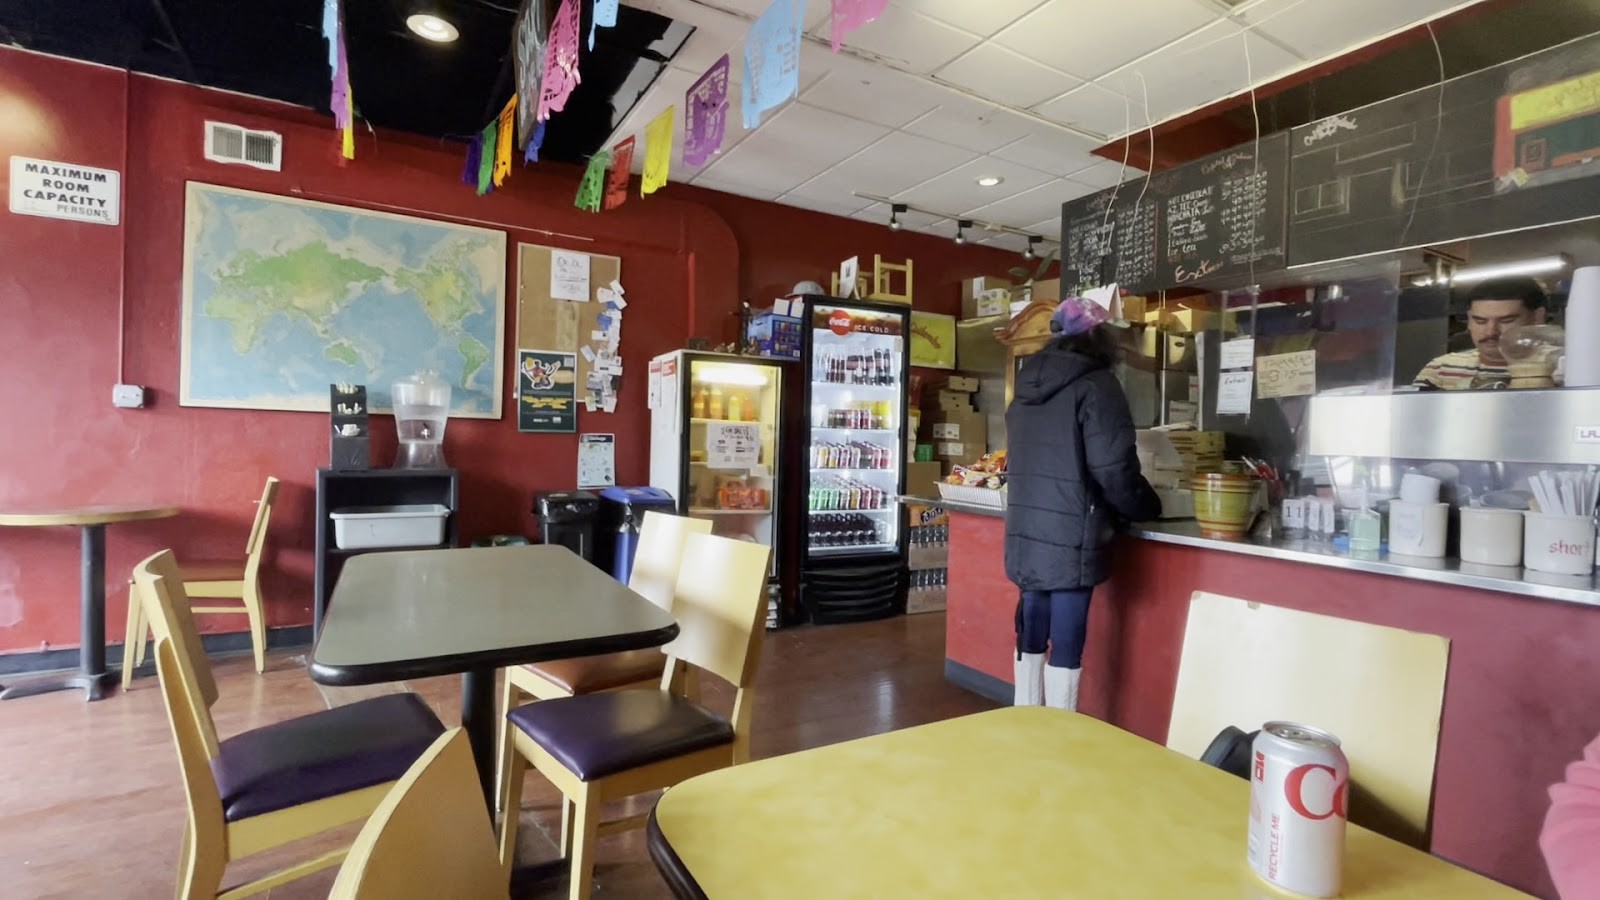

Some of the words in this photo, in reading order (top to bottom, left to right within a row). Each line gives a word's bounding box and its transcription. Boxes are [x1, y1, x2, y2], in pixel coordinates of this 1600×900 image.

[25, 163, 107, 183] MAXIMUM
[42, 178, 89, 193] ROOM
[24, 189, 106, 208] CAPACITY
[57, 204, 108, 217] PERSONS
[1273, 813, 1281, 831] ME
[1268, 831, 1280, 880] RECYCLE
